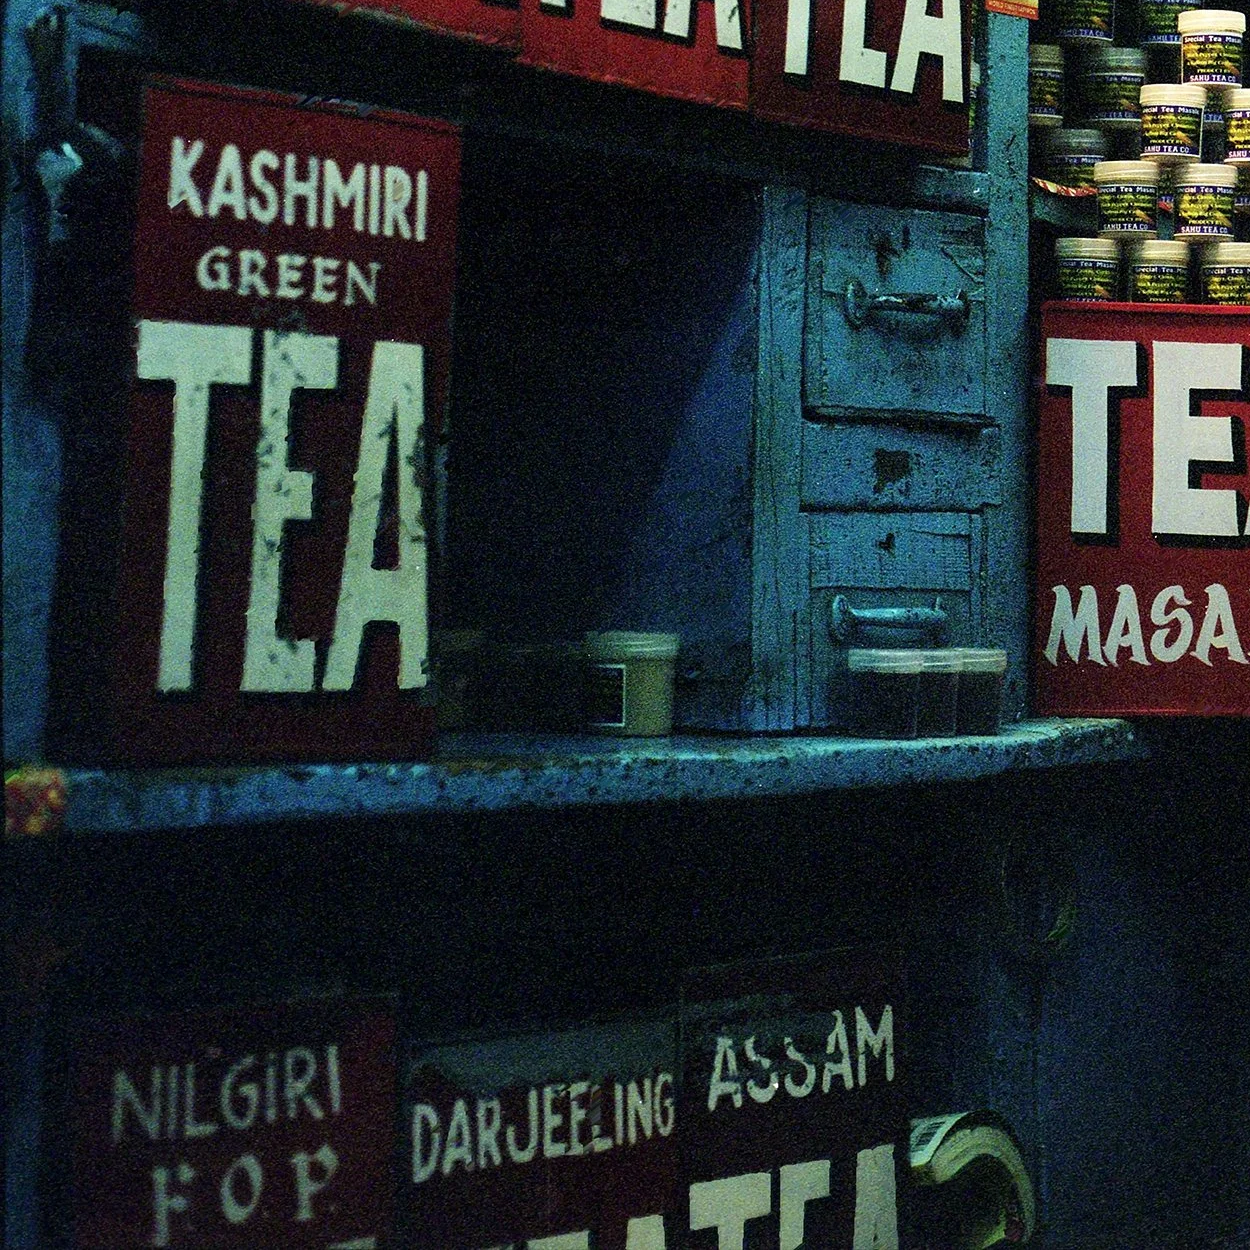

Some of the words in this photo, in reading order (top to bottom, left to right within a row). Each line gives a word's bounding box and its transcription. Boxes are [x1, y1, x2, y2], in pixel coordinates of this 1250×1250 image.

[167, 136, 428, 242] KASHMIRI
[197, 246, 381, 306] GREEN
[136, 319, 430, 693] TEA
[111, 1044, 341, 1143] NILGIRI
[707, 1003, 895, 1113] ASSAM
[411, 1072, 675, 1184] DARJEELING
